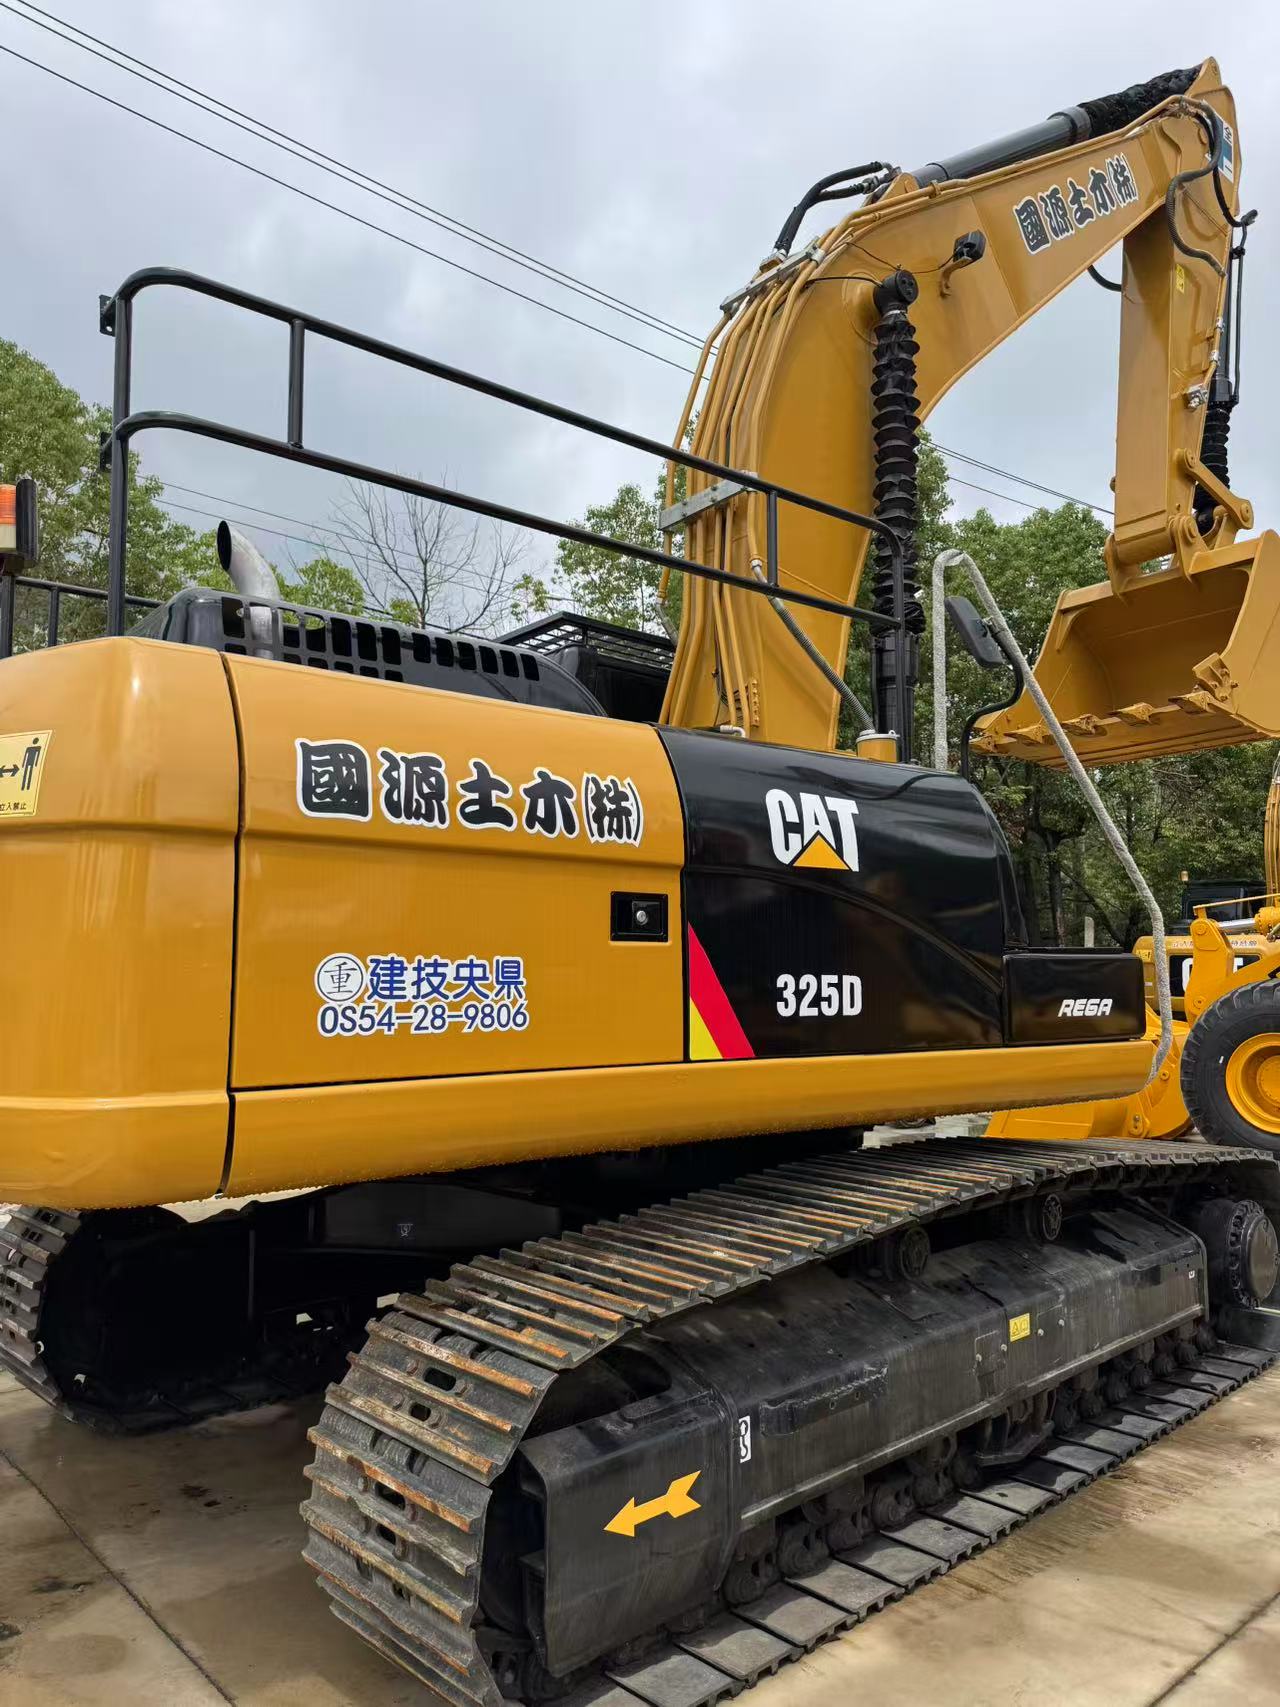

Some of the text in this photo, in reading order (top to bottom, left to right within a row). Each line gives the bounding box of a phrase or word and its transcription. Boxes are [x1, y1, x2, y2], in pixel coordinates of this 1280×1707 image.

[766, 788, 860, 872] CAT
[776, 973, 863, 1017] 325D
[1057, 998, 1113, 1018] REGA
